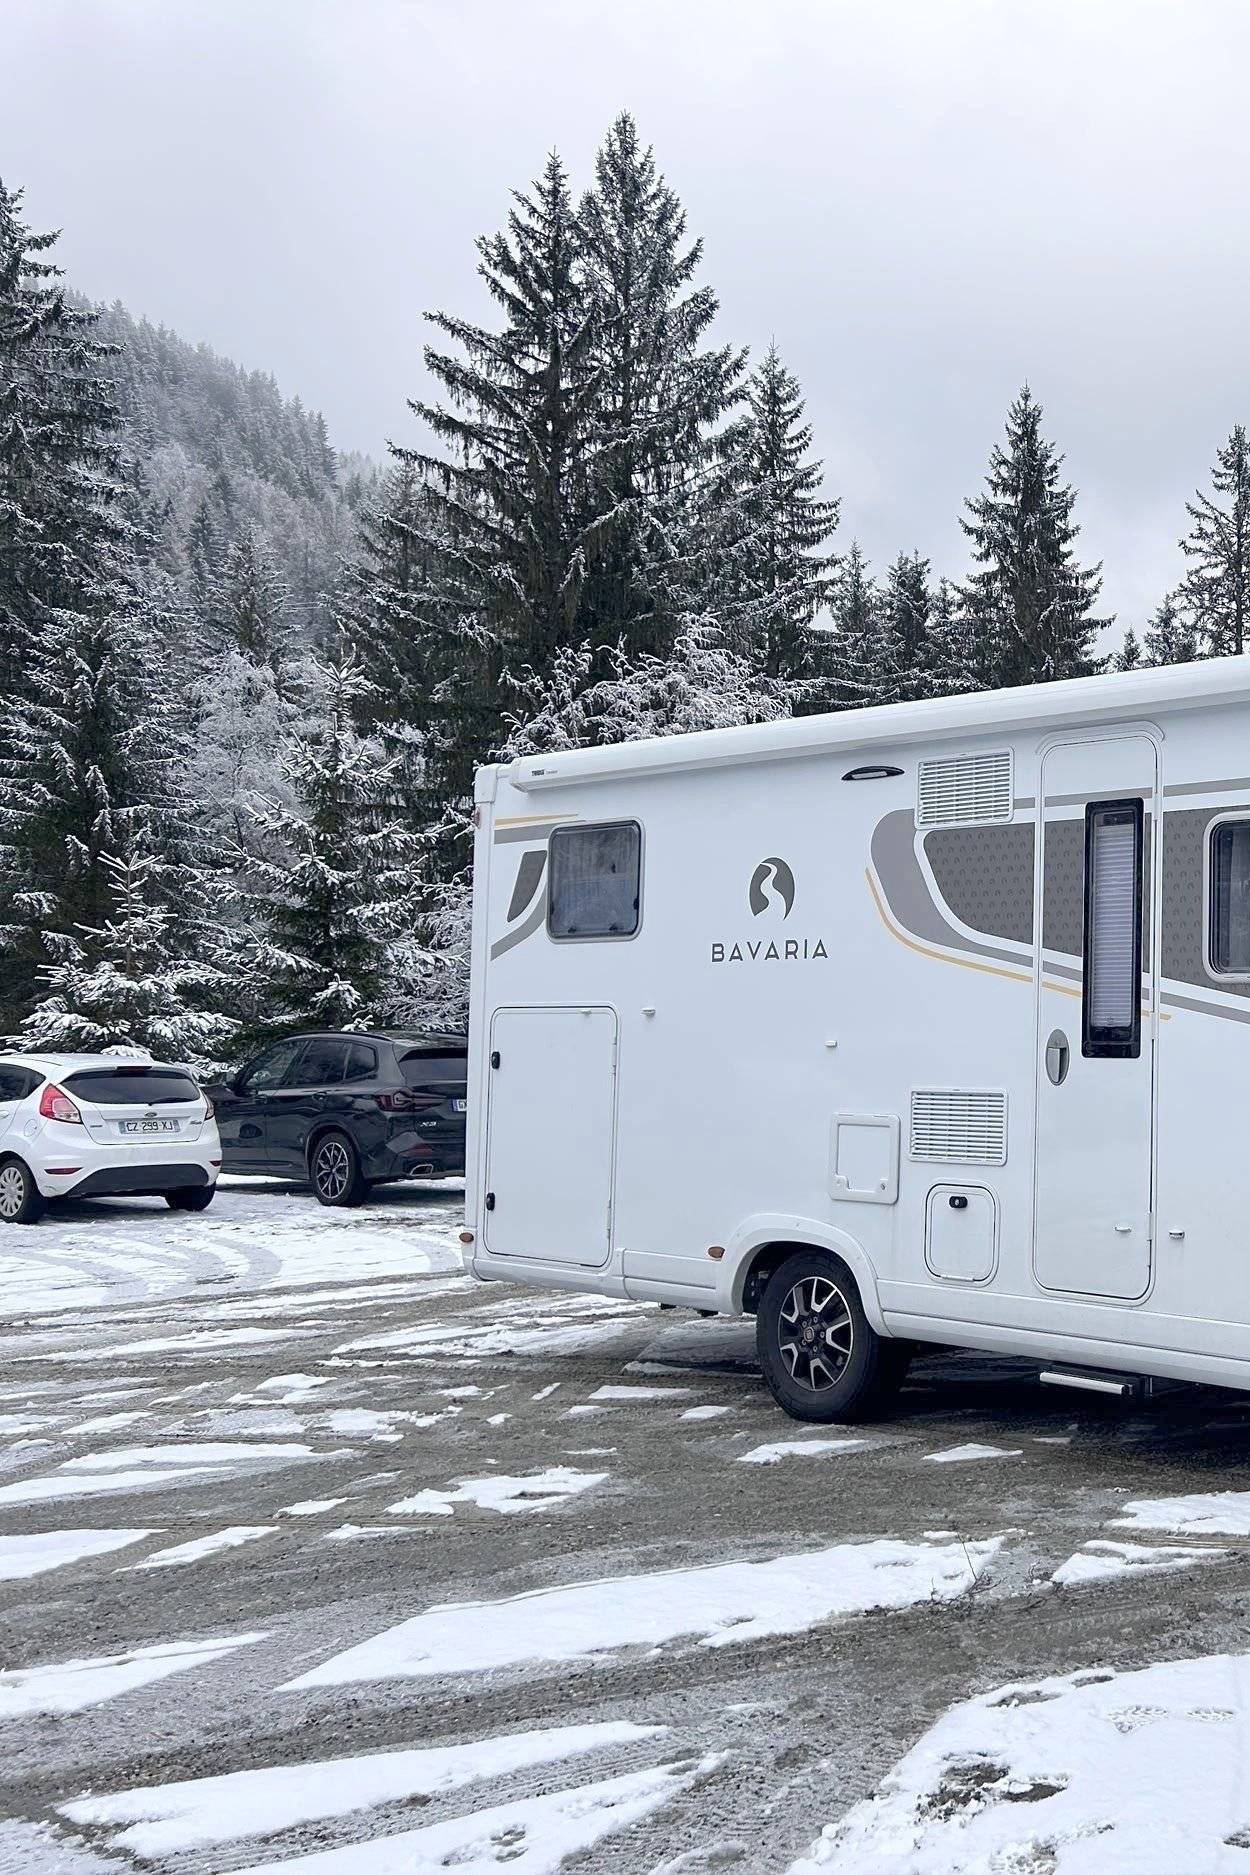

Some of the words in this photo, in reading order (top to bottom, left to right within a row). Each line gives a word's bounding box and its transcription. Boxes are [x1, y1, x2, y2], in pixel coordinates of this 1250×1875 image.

[711, 939, 828, 963] BAVARIA
[126, 1122, 138, 1131] CZ
[142, 1121, 159, 1131] 299
[162, 1121, 173, 1130] XJ
